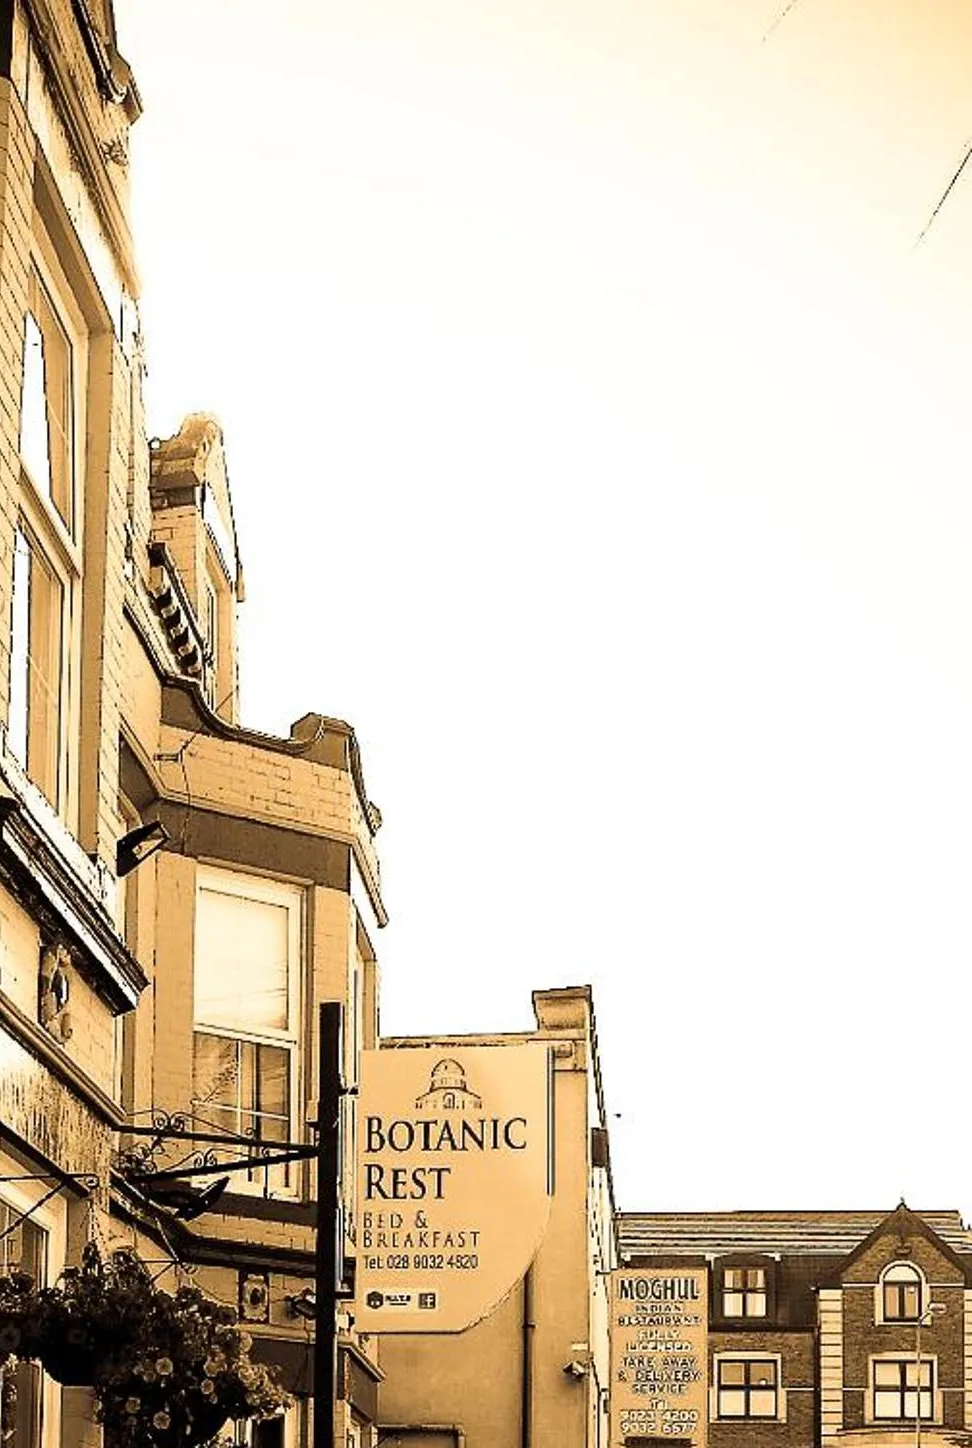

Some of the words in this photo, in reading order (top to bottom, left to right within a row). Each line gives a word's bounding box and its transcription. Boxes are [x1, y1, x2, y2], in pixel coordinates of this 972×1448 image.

[364, 1117, 527, 1152] BOTANIC
[364, 1164, 451, 1200] REST
[364, 1212, 403, 1228] BED
[415, 1211, 428, 1228] &
[364, 1231, 481, 1248] BREAKFAST
[386, 1254, 409, 1269] 028
[414, 1254, 443, 1269] 9032
[620, 1279, 699, 1300] MOGHUL
[635, 1304, 683, 1314] INDIAN
[622, 1357, 654, 1368] TAKE
[662, 1357, 697, 1368] AWAY
[635, 1370, 701, 1382] DELIVERY
[632, 1384, 687, 1395] SERVICE
